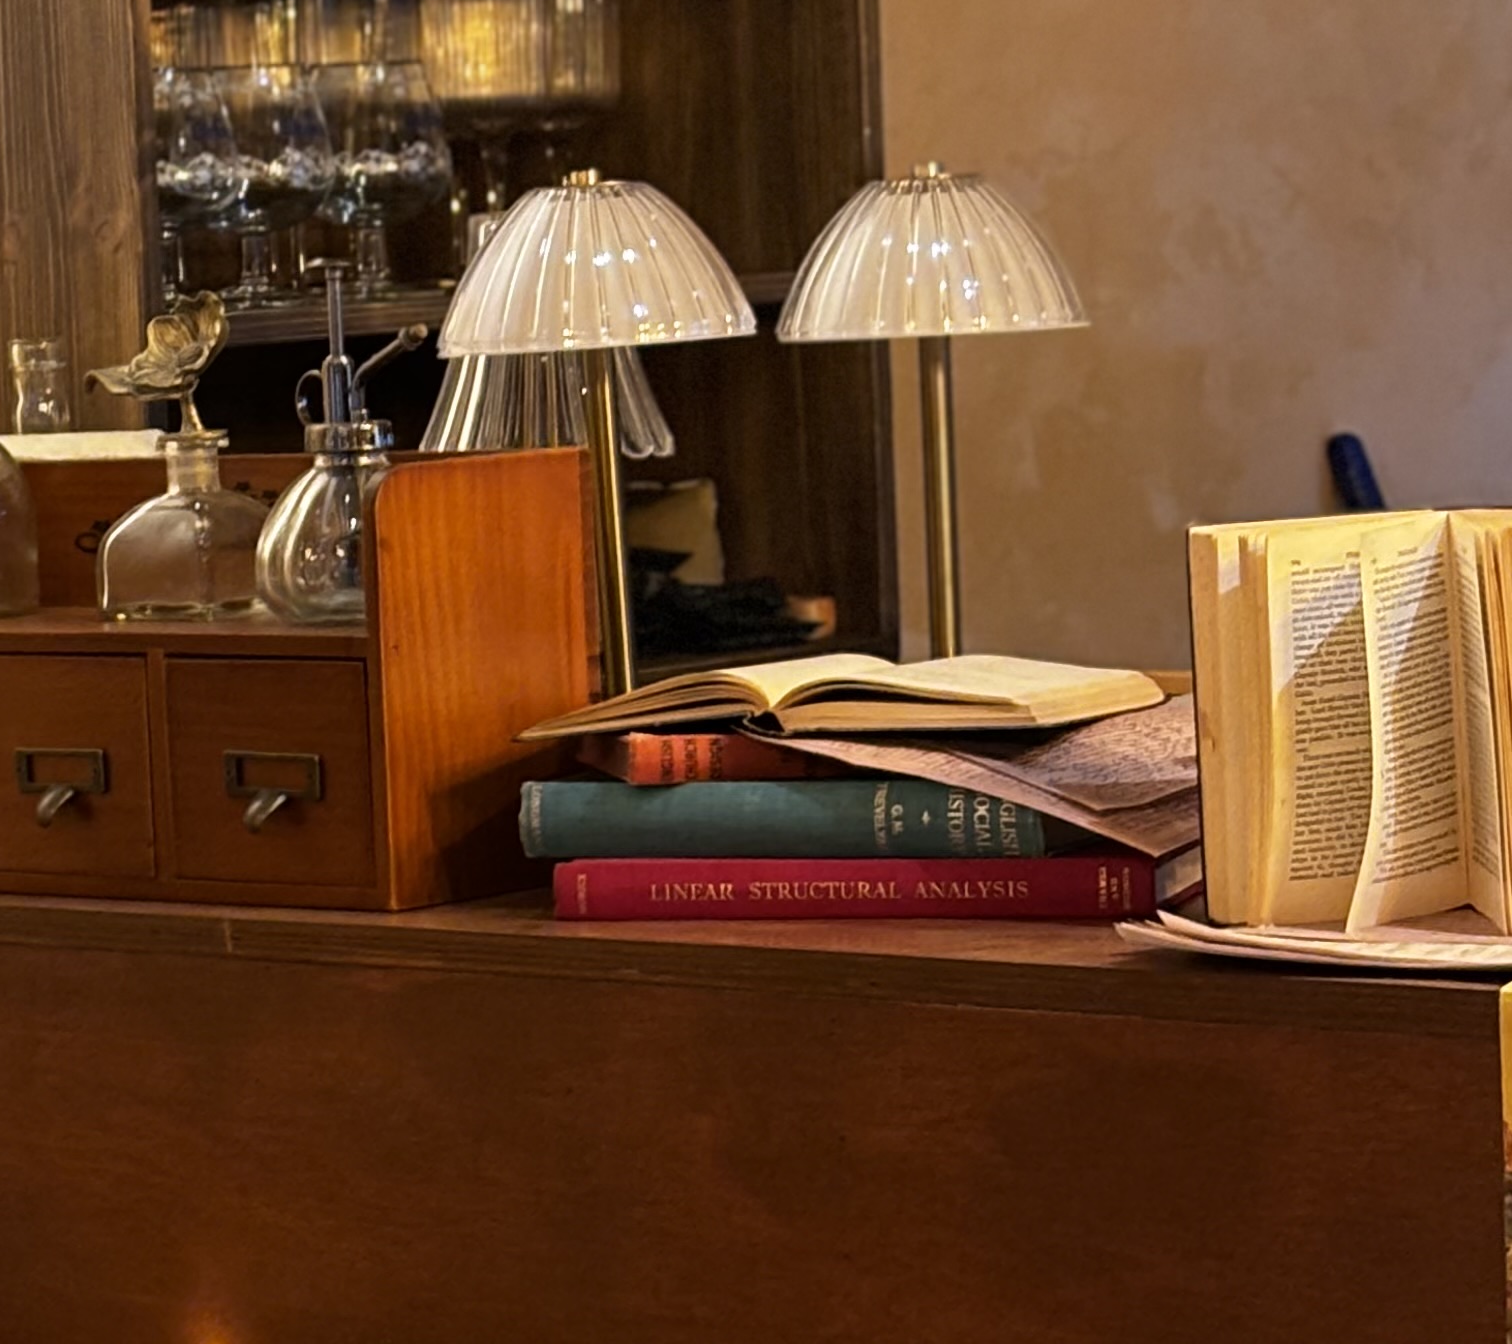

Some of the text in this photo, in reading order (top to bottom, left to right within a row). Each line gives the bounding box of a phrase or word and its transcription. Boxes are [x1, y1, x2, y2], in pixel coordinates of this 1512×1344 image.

[972, 793, 992, 852] OCIAL
[999, 799, 1021, 855] GLISH
[650, 880, 1029, 902] LINEAR STRUCTURAL ANALYSIS
